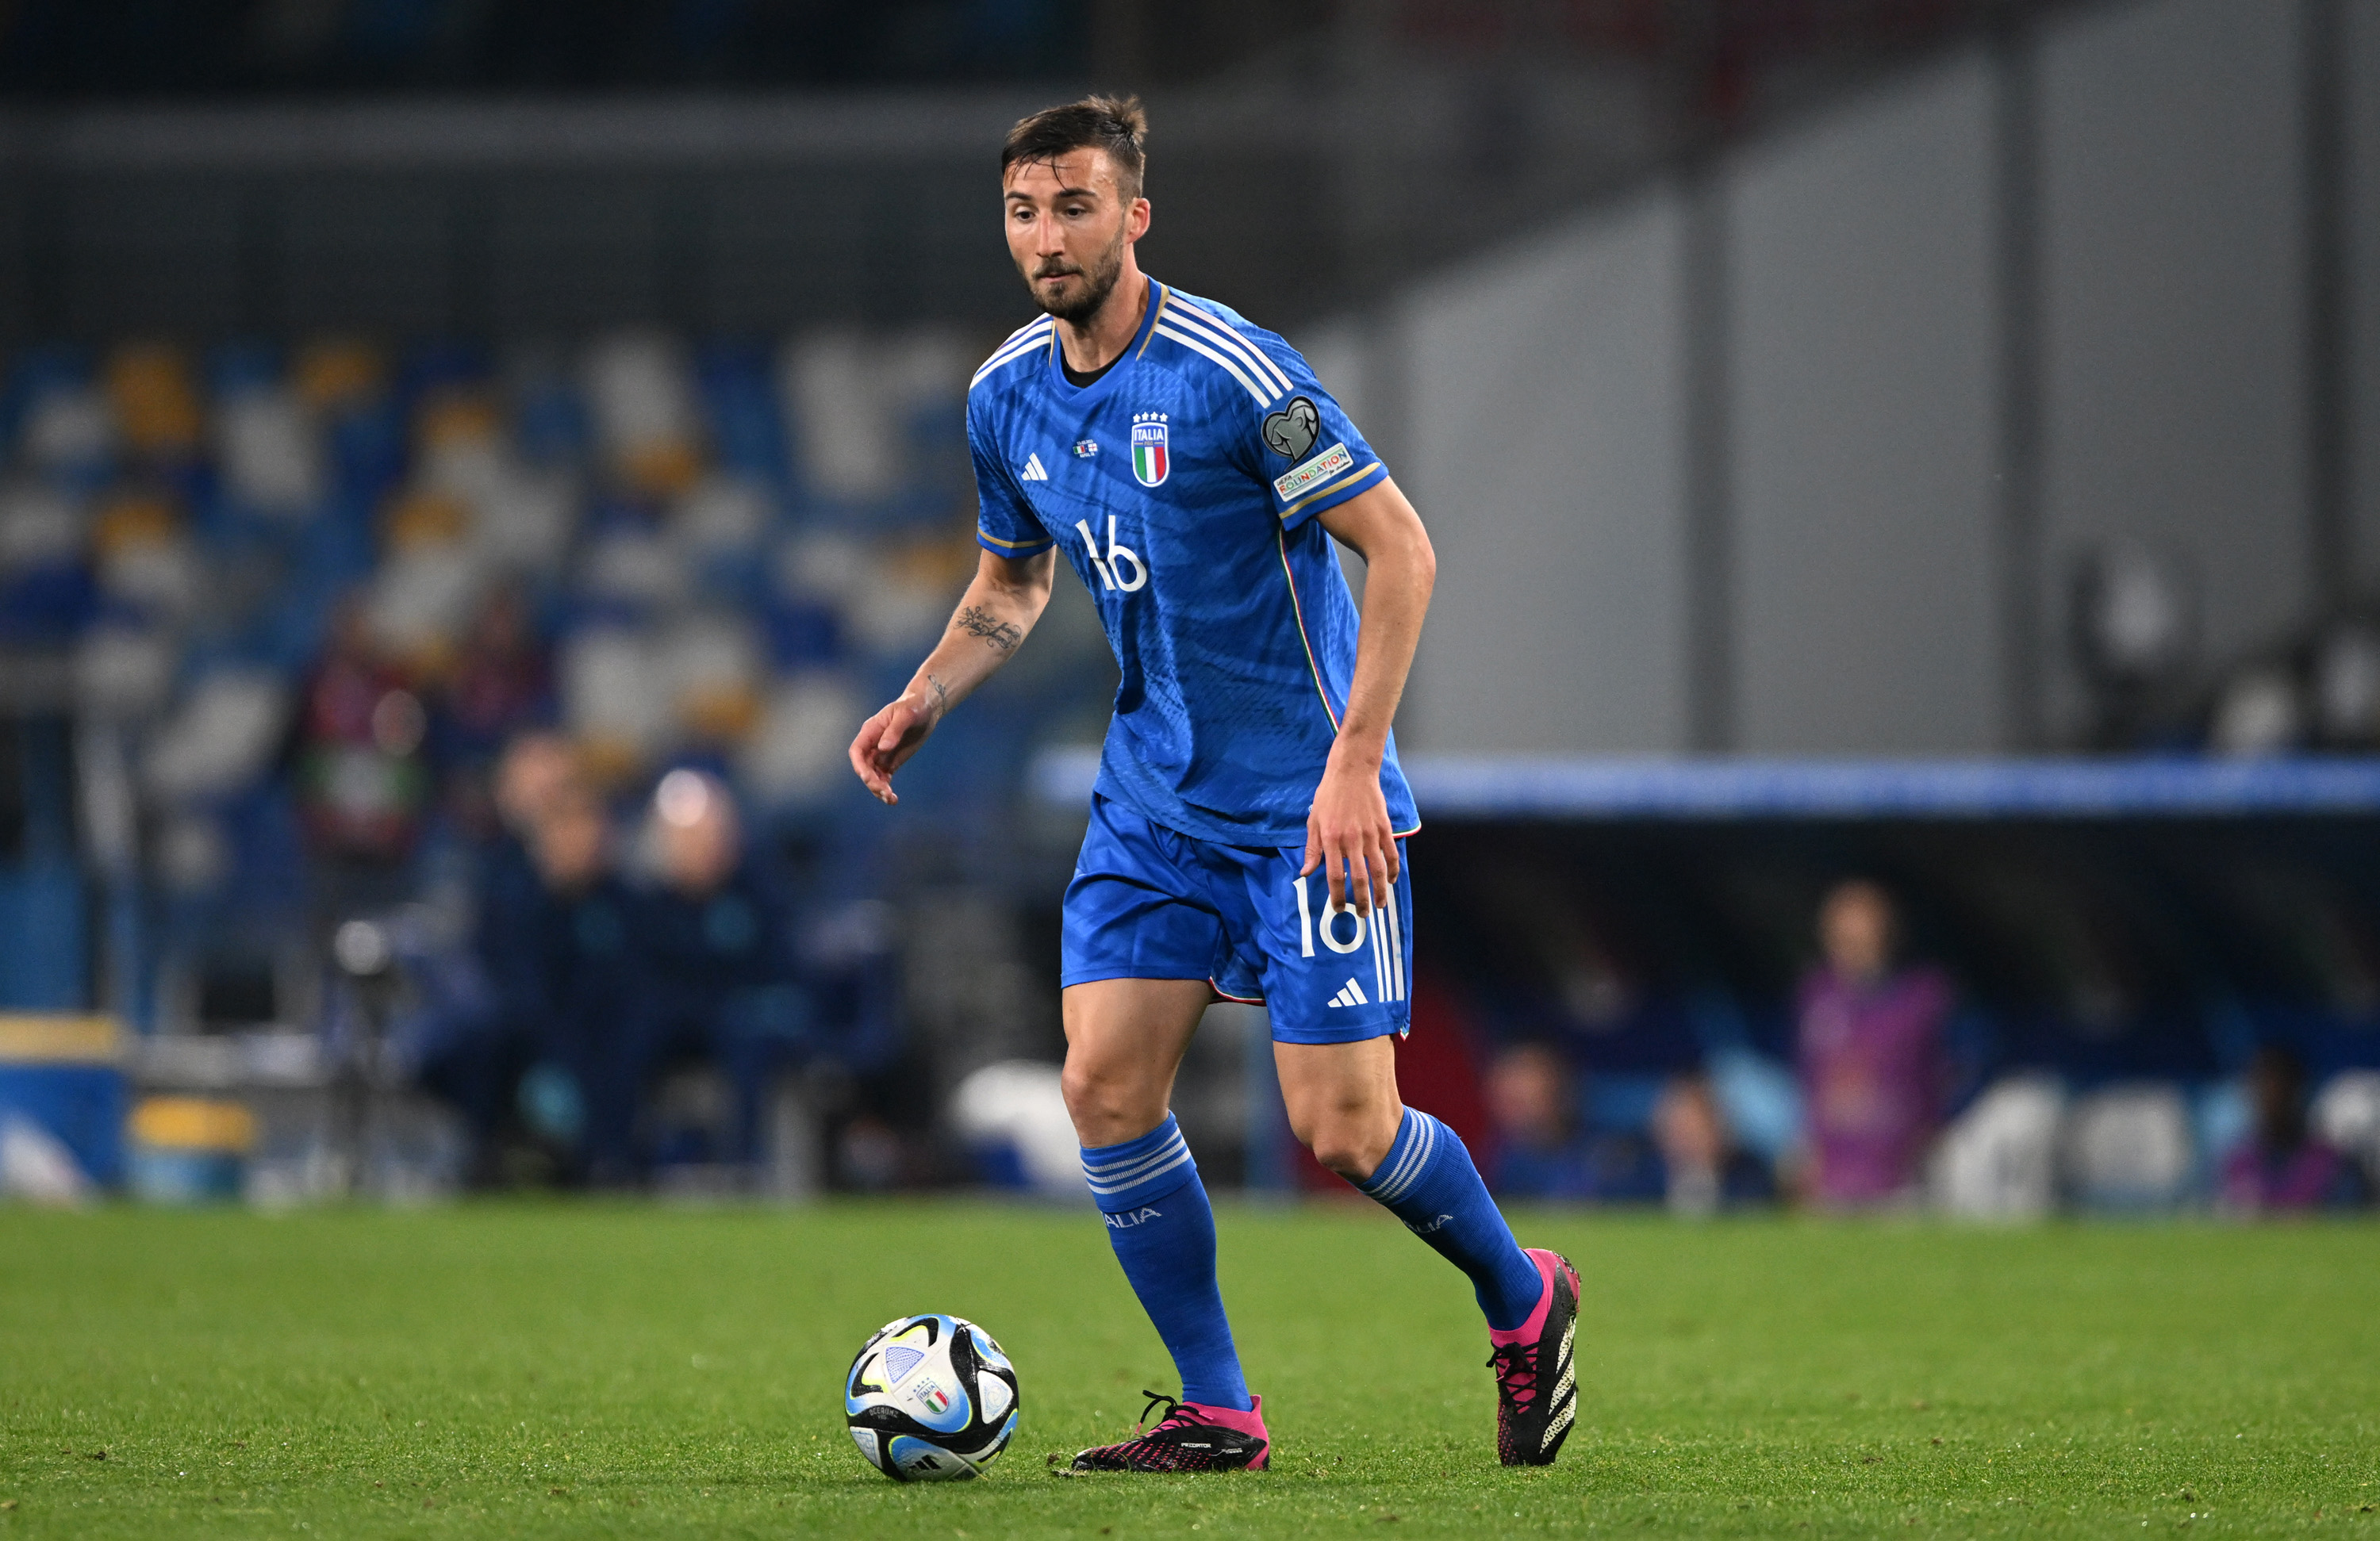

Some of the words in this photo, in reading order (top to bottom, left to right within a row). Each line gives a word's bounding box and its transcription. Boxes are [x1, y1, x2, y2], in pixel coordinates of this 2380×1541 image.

[1134, 428, 1164, 441] ITALIA
[1279, 450, 1348, 493] FOUNDATION
[1075, 515, 1147, 592] 16
[1292, 872, 1367, 958] 16
[919, 1384, 935, 1400] ITALIA
